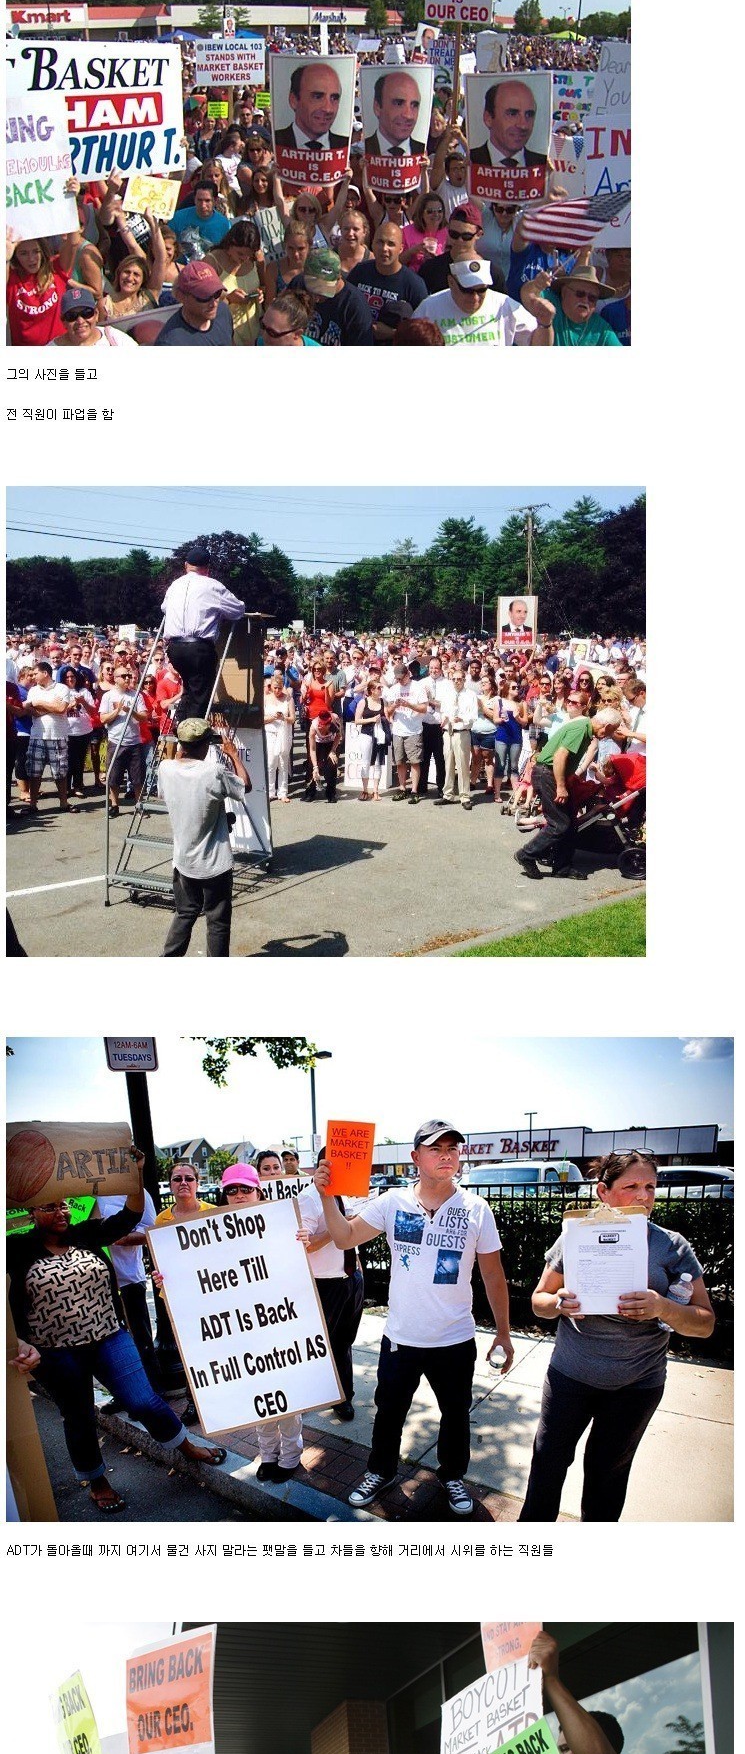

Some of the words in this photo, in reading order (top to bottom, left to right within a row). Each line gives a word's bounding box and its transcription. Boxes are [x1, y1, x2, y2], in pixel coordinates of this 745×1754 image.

[11, 9, 71, 24] Kmart
[427, 4, 455, 19] OUR
[460, 6, 489, 21] CEO
[204, 43, 223, 51] IBEW
[225, 43, 248, 51] LOCAL
[250, 43, 262, 51] 103
[21, 47, 169, 91] BASKET
[197, 63, 231, 71] MARKET
[233, 63, 264, 71] BASKET
[211, 73, 251, 82] WORKERS
[69, 130, 156, 176] RTHUR
[164, 128, 181, 165] T.
[281, 149, 333, 161] ARTHUR
[282, 169, 307, 181] OUR
[309, 163, 319, 171] IS
[17, 292, 58, 315] STRONG
[113, 1053, 152, 1062] TUESDAYS
[332, 1127, 348, 1137] WE
[350, 1129, 370, 1138] ARE
[330, 1138, 370, 1149] MARKET
[500, 1138, 559, 1154] BASKET
[330, 1149, 368, 1160] BASKET
[57, 1147, 131, 1181] ARTIE
[86, 1176, 106, 1195] T
[447, 1207, 471, 1217] GUEST
[438, 1216, 470, 1230] LISTS
[176, 1219, 222, 1250] Don't
[223, 1213, 266, 1240] Shop
[425, 1233, 467, 1249] GUESTS
[197, 1268, 239, 1294] Here
[239, 1255, 269, 1284] Till
[200, 1311, 233, 1342] ADT
[235, 1309, 251, 1333] Is
[254, 1297, 298, 1328] Back
[190, 1366, 209, 1389] In
[209, 1356, 242, 1385] Full
[243, 1340, 301, 1377] Control
[306, 1334, 327, 1361] AS
[254, 1390, 288, 1418] CEO
[129, 1658, 165, 1694] BRING
[168, 1647, 203, 1683] BACK
[487, 1684, 530, 1729] BASKET
[137, 1710, 162, 1742] OUR
[164, 1703, 194, 1736] CEO.
